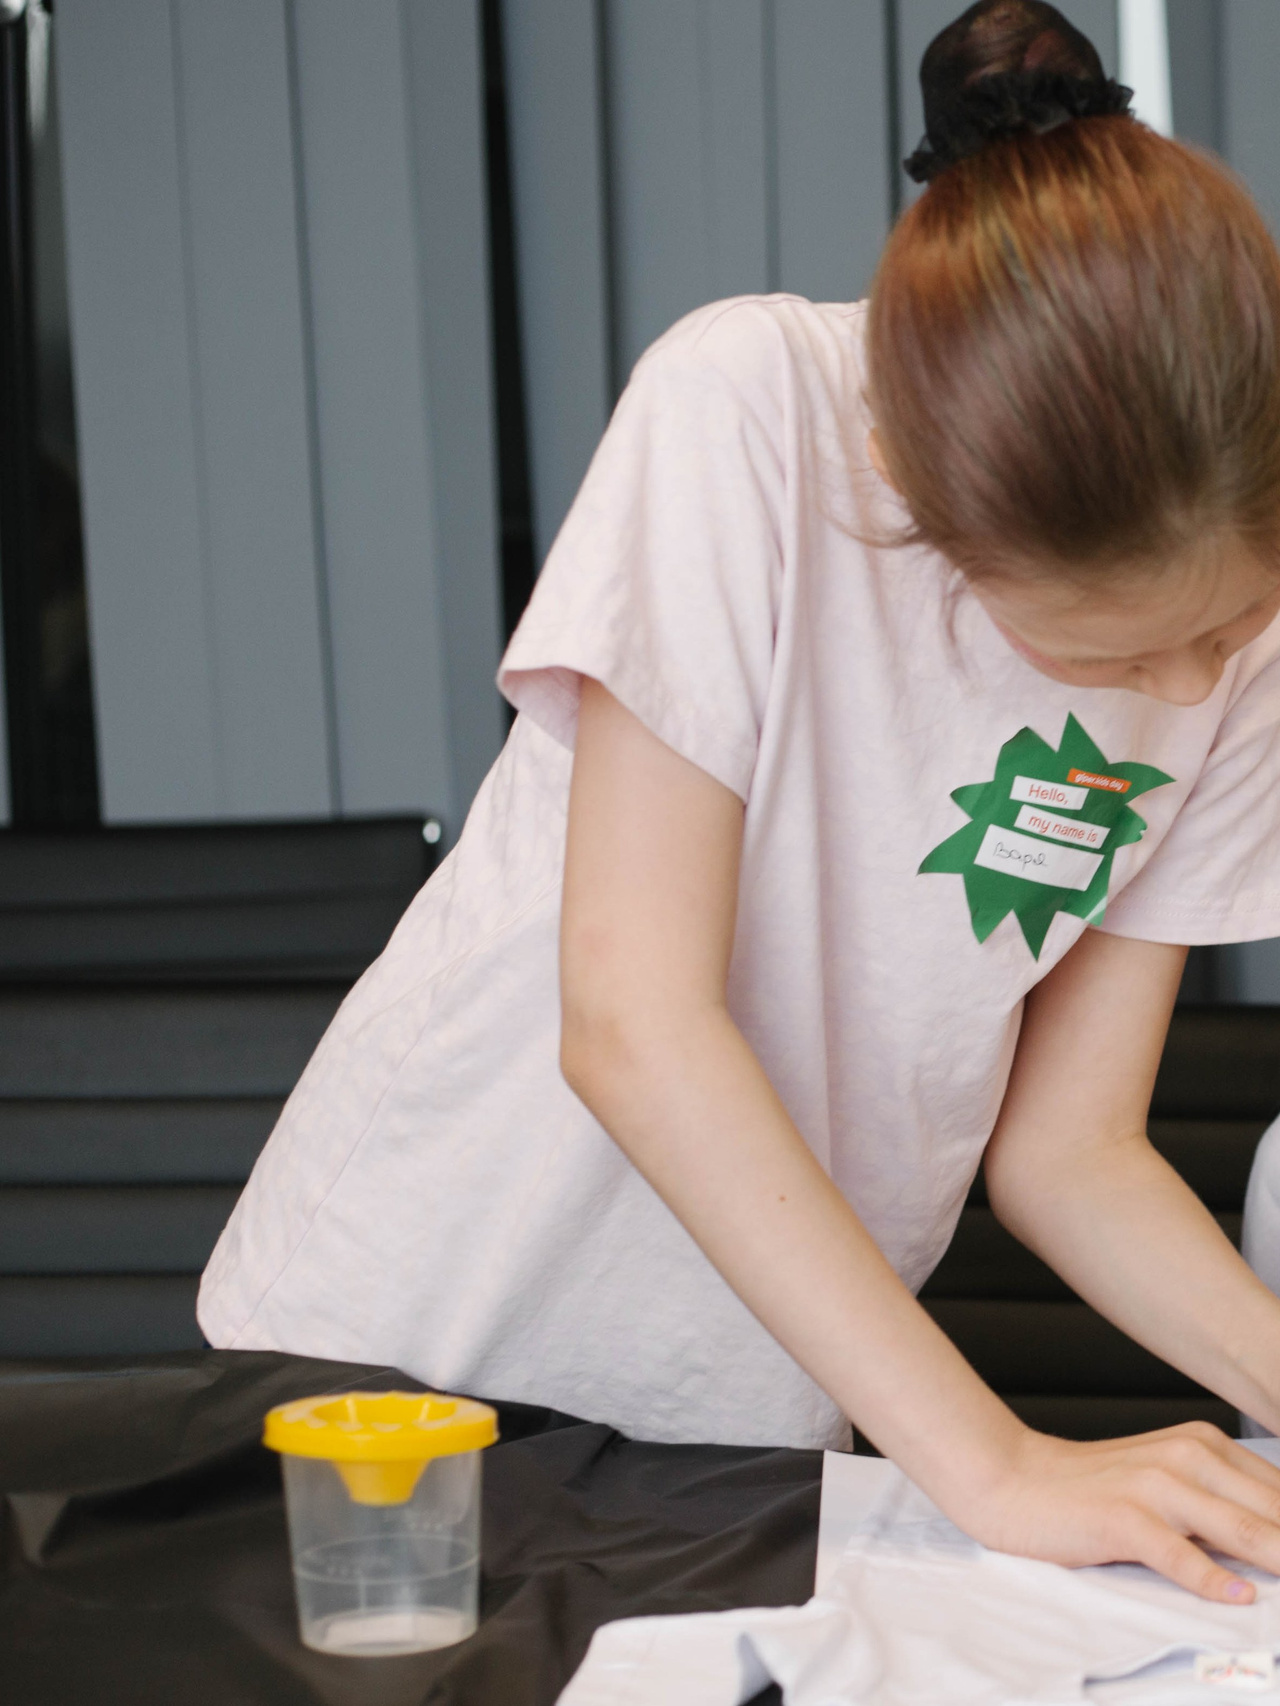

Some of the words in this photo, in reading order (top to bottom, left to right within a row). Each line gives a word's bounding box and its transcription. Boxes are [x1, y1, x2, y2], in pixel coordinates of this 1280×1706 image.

[1028, 784, 1069, 804] Hello,
[1028, 815, 1049, 833] my
[1052, 821, 1084, 840] name
[1086, 829, 1099, 843] is
